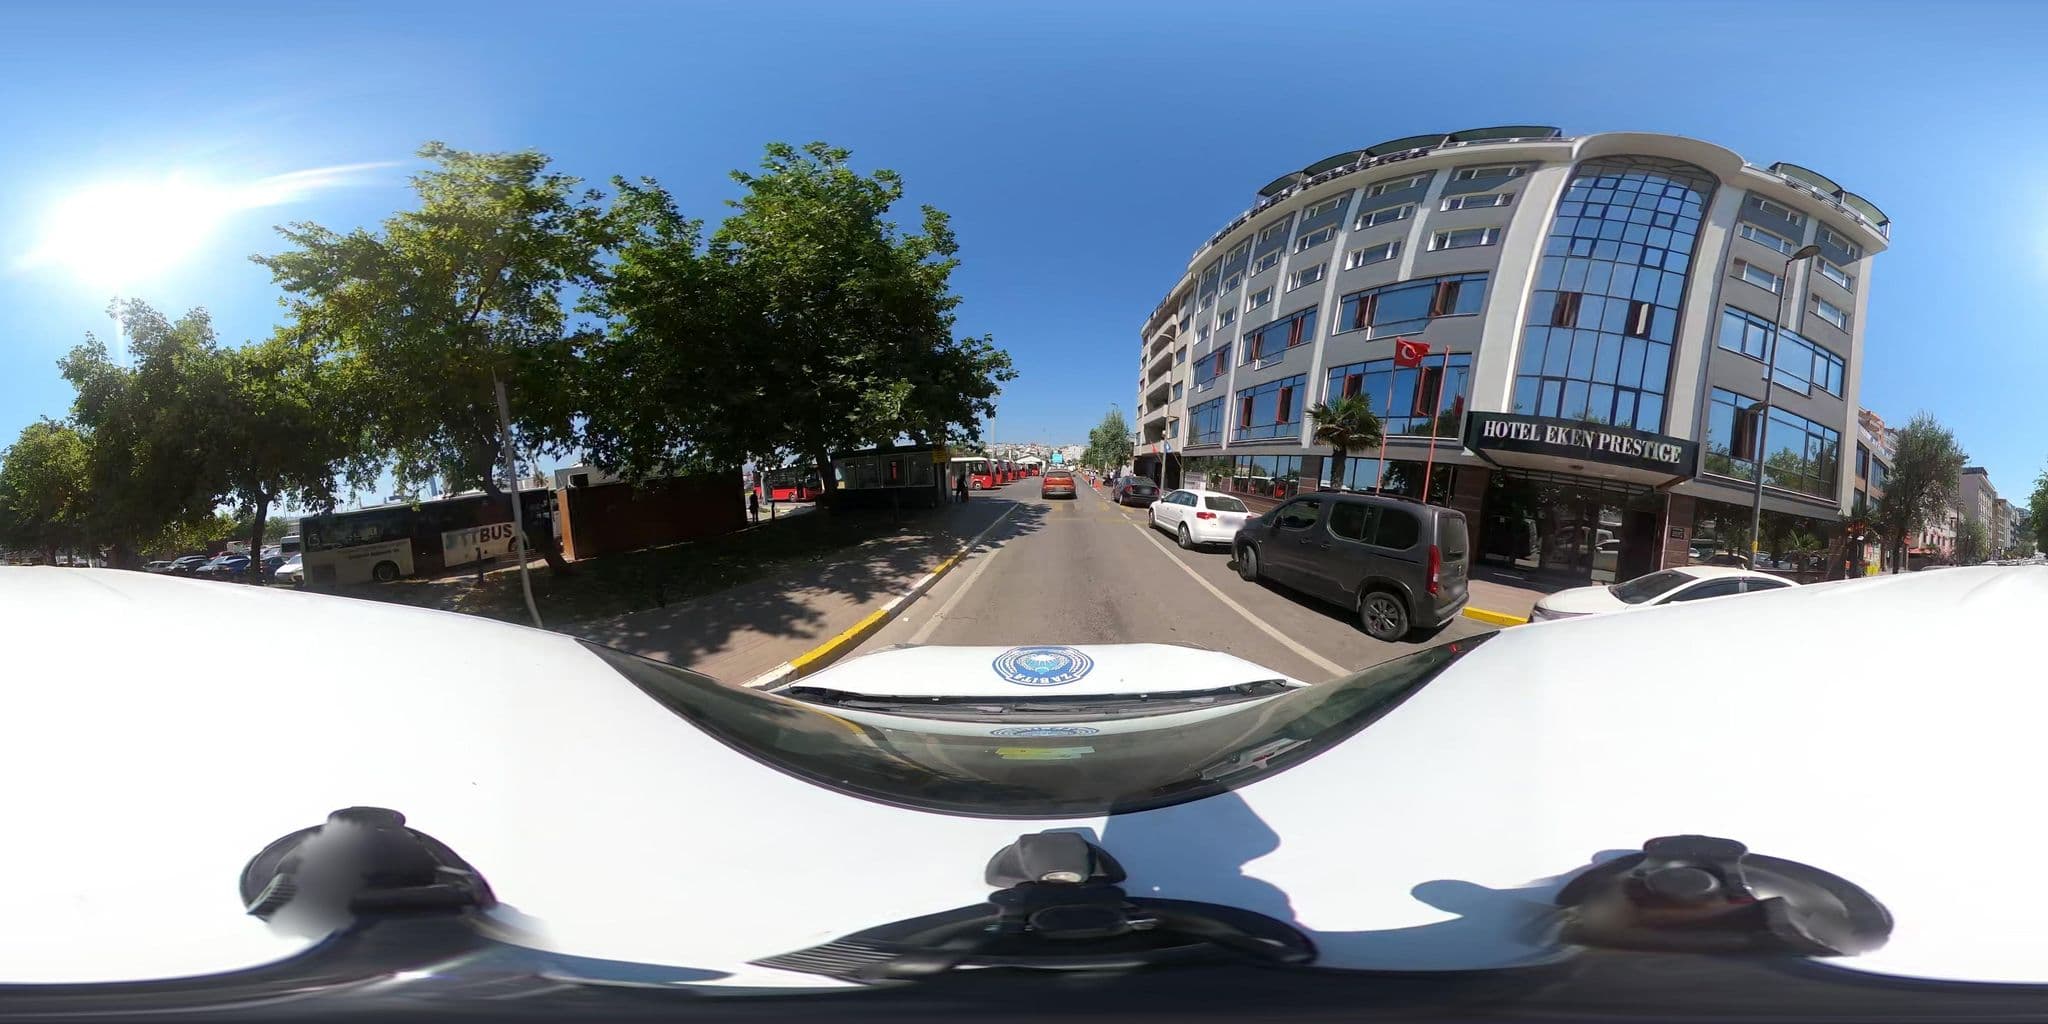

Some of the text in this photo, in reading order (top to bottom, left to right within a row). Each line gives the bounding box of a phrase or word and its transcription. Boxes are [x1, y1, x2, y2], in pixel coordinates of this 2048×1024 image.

[1483, 420, 1682, 464] HOTEL EKEN PRESTIGE
